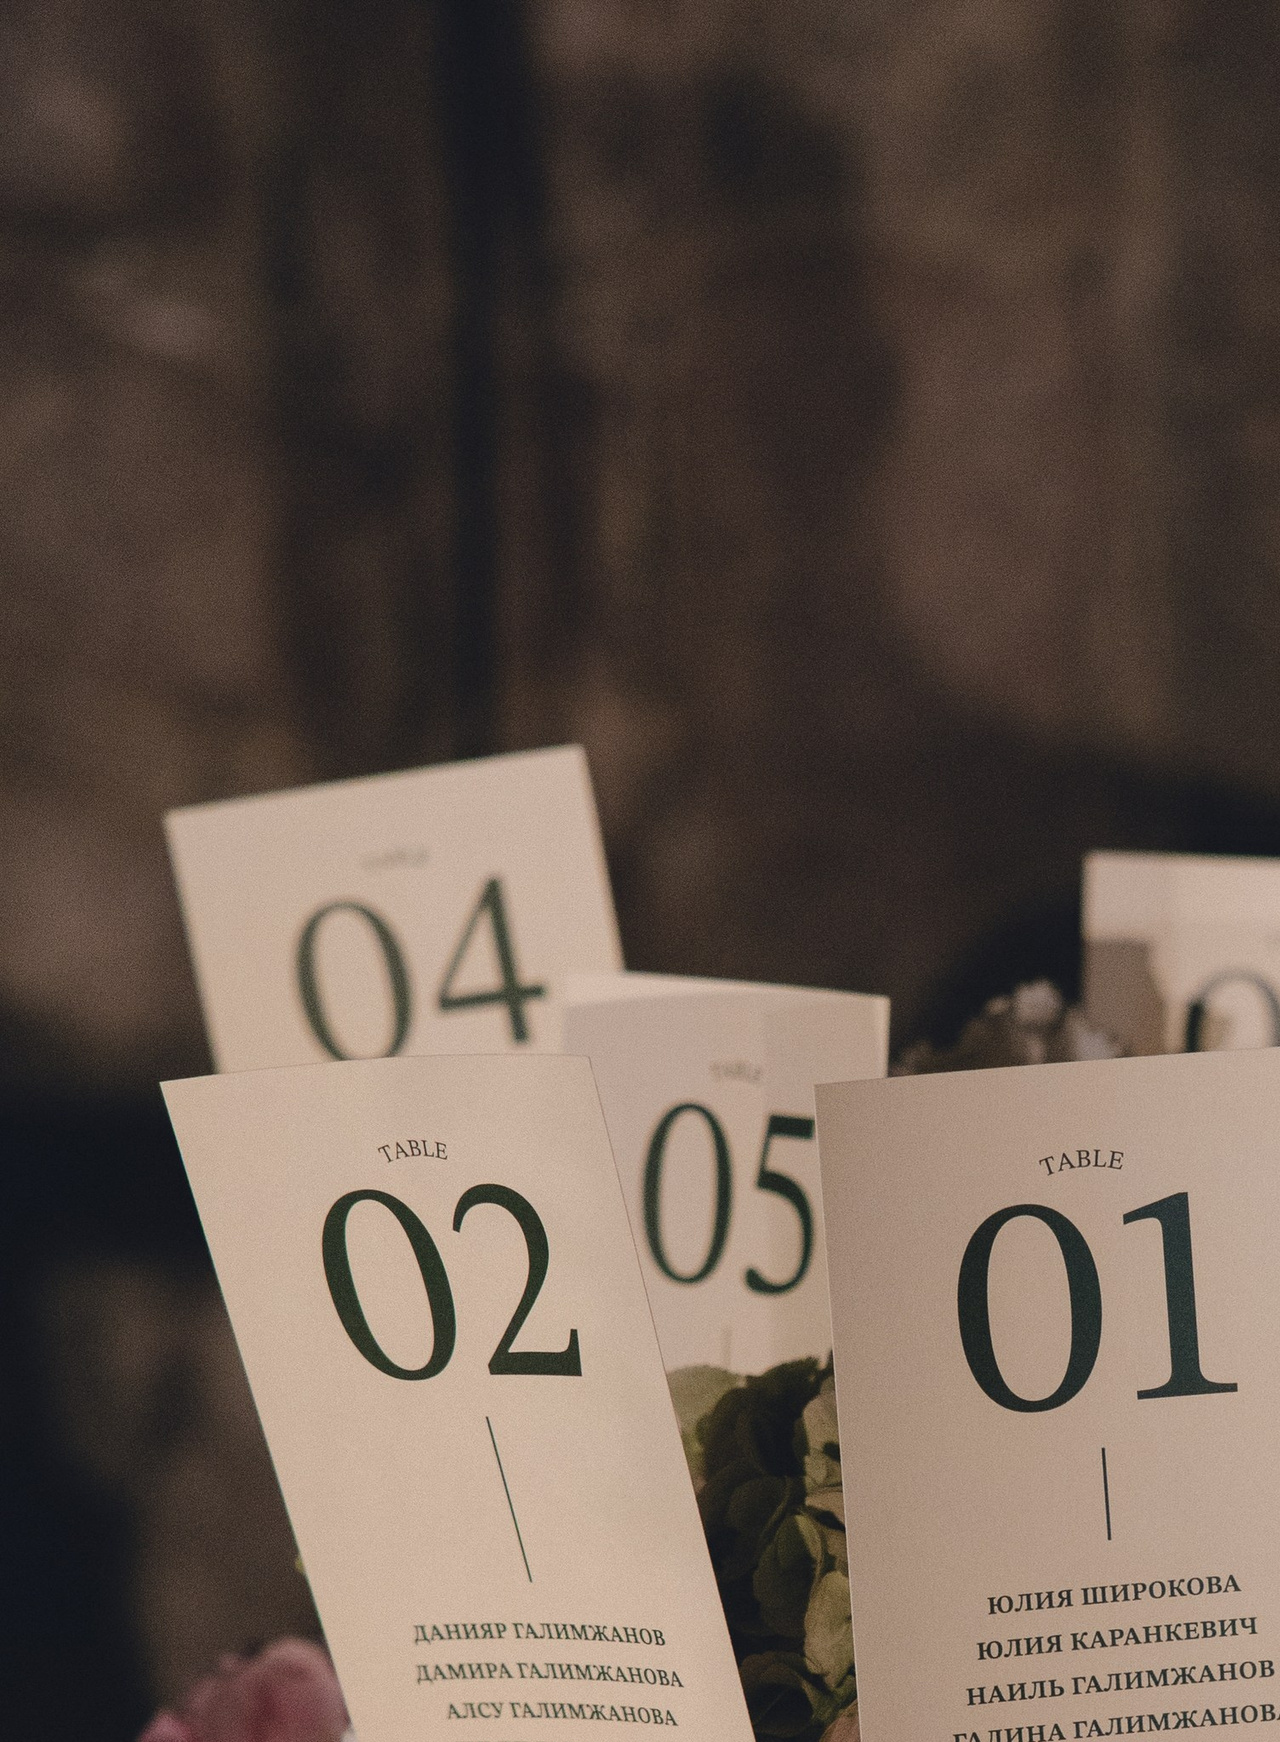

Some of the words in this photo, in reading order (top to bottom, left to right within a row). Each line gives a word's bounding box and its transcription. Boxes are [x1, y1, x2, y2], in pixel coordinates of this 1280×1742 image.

[297, 873, 546, 1058] 04
[377, 1139, 448, 1163] TABLE
[1038, 1149, 1124, 1176] TABLE
[642, 1102, 816, 1295] 05
[321, 1183, 582, 1380] 02
[957, 1191, 1239, 1414] 01
[987, 1589, 1073, 1615] ЮЛИЯ
[1081, 1574, 1241, 1606] ШИРОКОВА
[414, 1623, 507, 1644] ДАНИЯР
[512, 1622, 666, 1646] ГАЛИМЖАНОВ
[977, 1634, 1063, 1661] ЮЛИЯ
[1070, 1616, 1257, 1651] КАРАНКЕВИЧ
[417, 1662, 513, 1684] ДАМИРА
[517, 1662, 684, 1688] ГАЛИМЖАНОВА
[966, 1679, 1065, 1706] НАИЛЬ
[1071, 1660, 1275, 1695] ГАЛИМЖАНОВ
[448, 1702, 503, 1719] АЛСУ
[509, 1702, 678, 1727] ГАЛИМЖАНОВА
